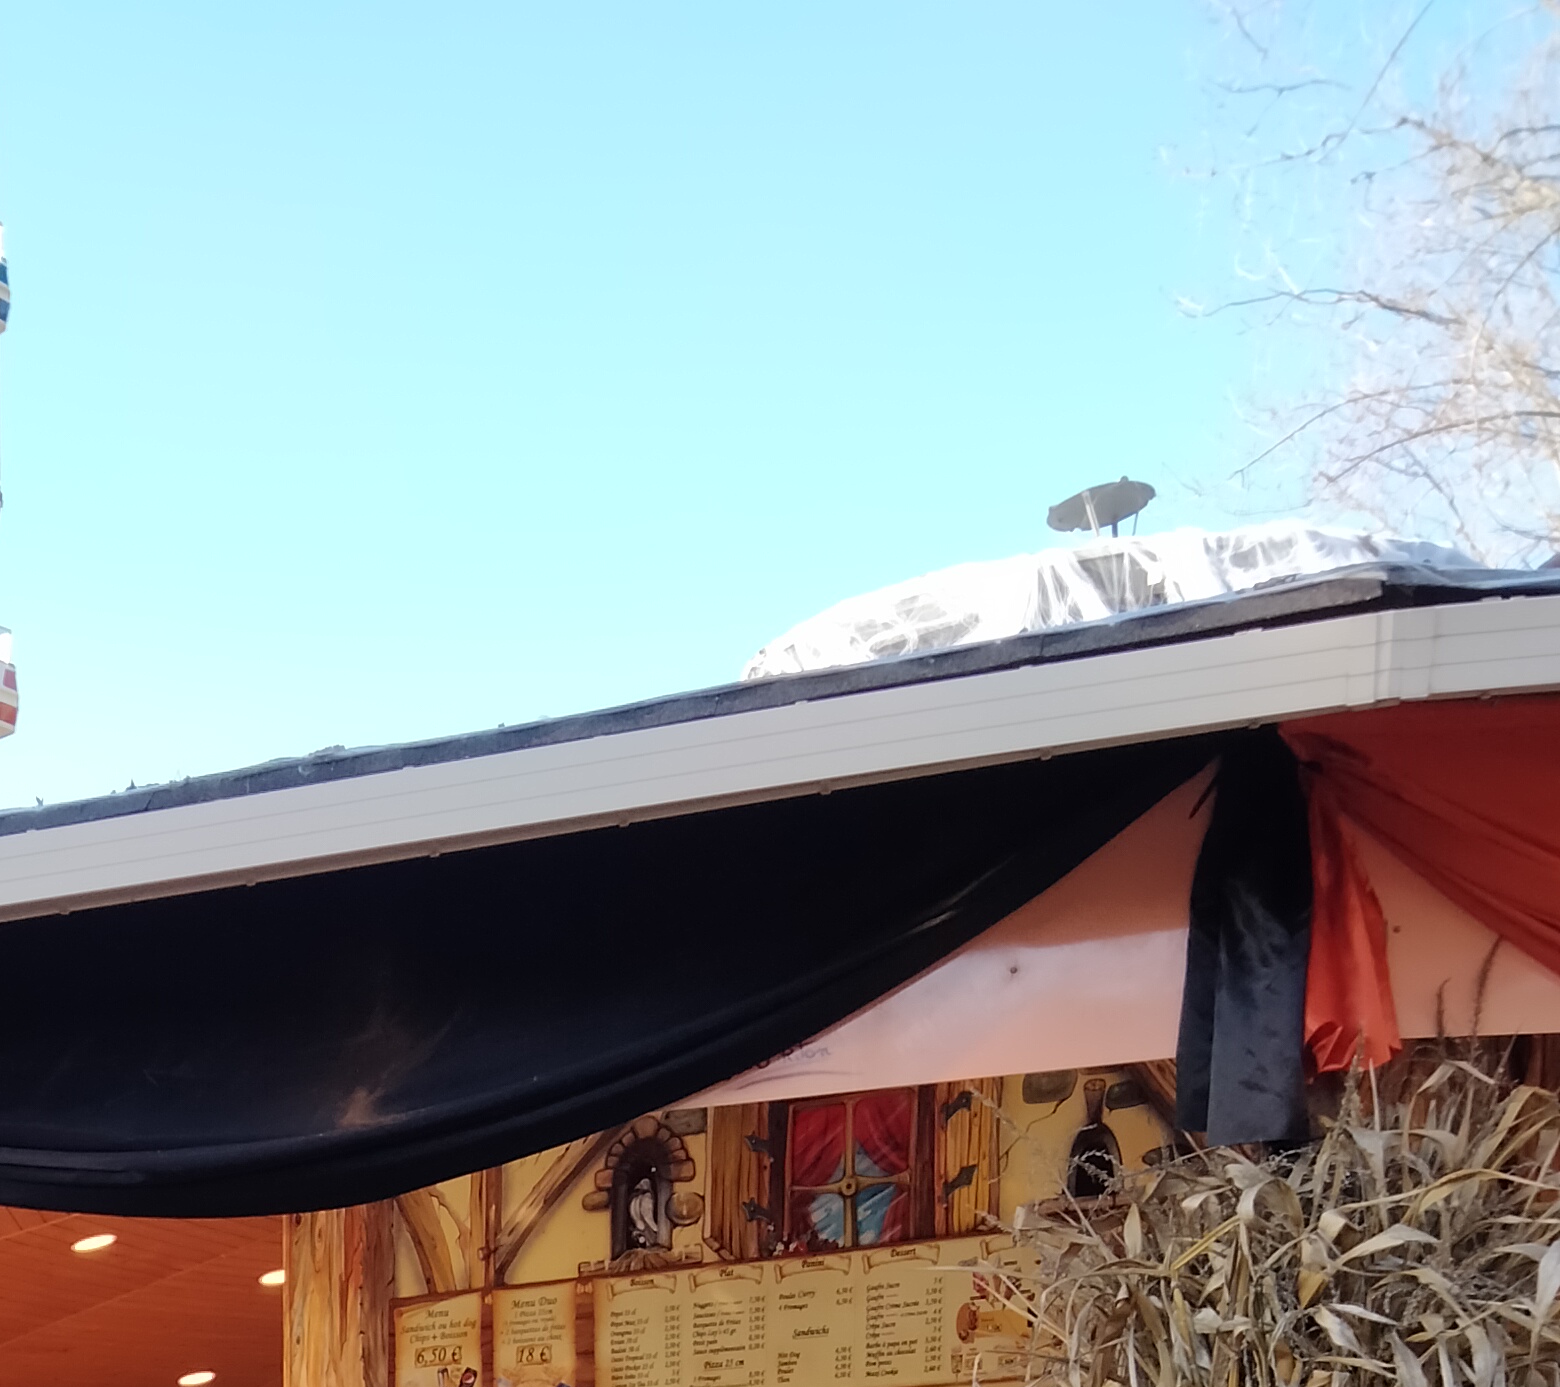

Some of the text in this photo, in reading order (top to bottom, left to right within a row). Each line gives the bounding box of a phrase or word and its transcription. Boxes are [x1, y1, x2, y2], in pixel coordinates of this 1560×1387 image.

[891, 1248, 916, 1257] Dessert
[802, 1259, 825, 1268] Panini
[719, 1267, 734, 1277] Plat
[511, 1296, 557, 1309] Menu Duo
[425, 1309, 449, 1319] Menu
[417, 1346, 461, 1366] 6,50 €
[519, 1346, 549, 1363] 18 €
